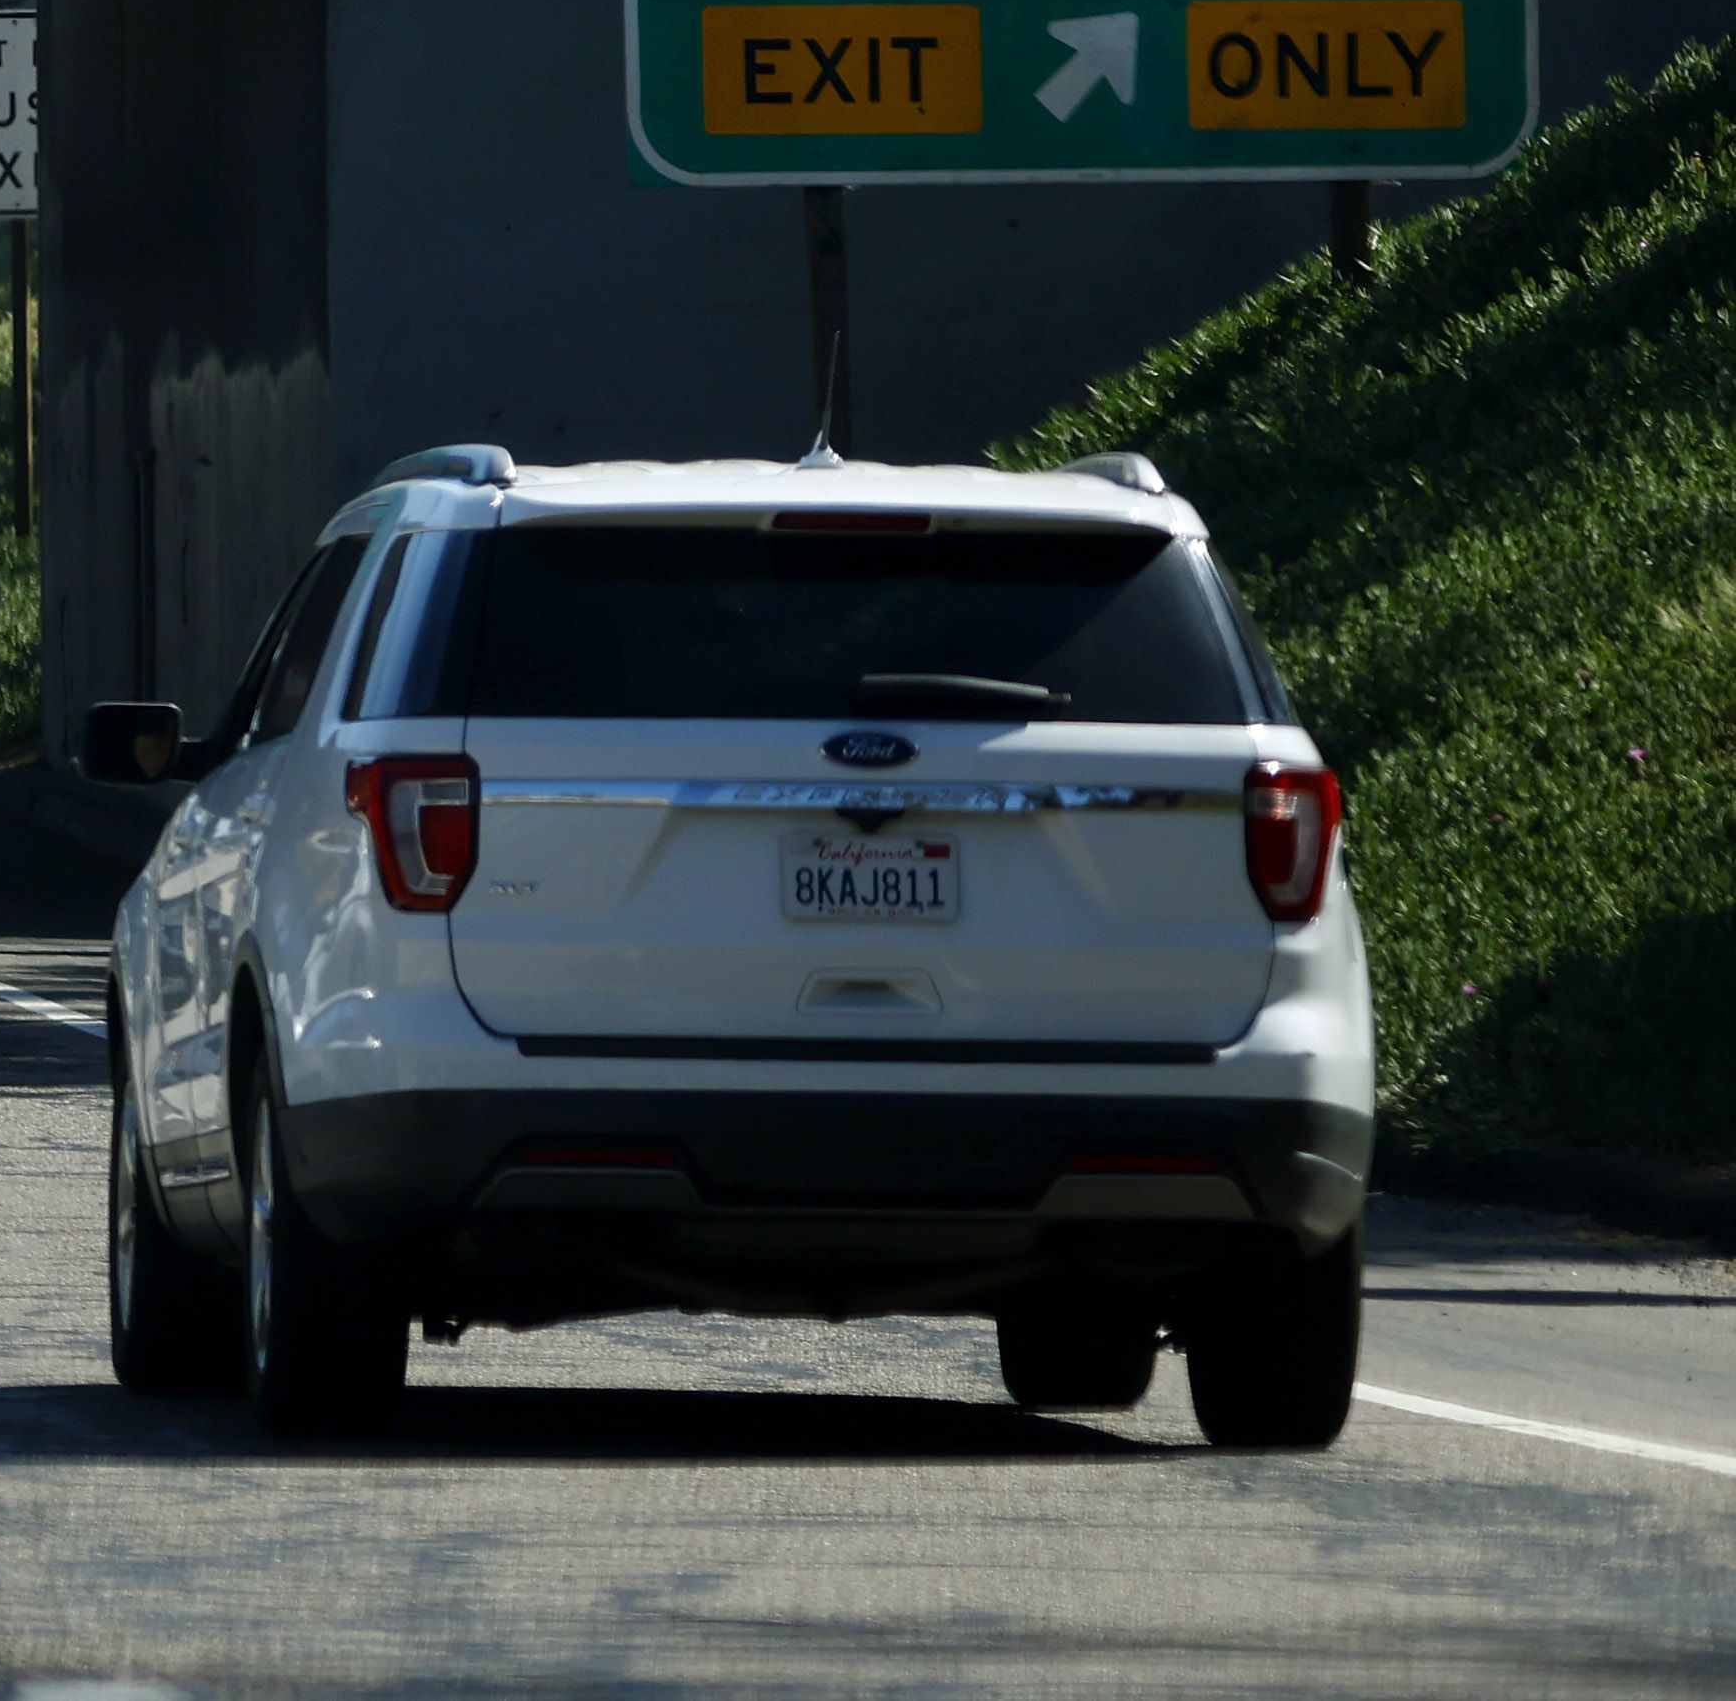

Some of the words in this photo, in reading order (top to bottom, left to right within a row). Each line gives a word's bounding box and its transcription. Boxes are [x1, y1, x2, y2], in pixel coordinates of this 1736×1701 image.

[743, 36, 939, 105] EXIT
[1209, 29, 1446, 99] ONLY
[818, 840, 914, 866] California
[795, 866, 945, 907] 8KAJ811
